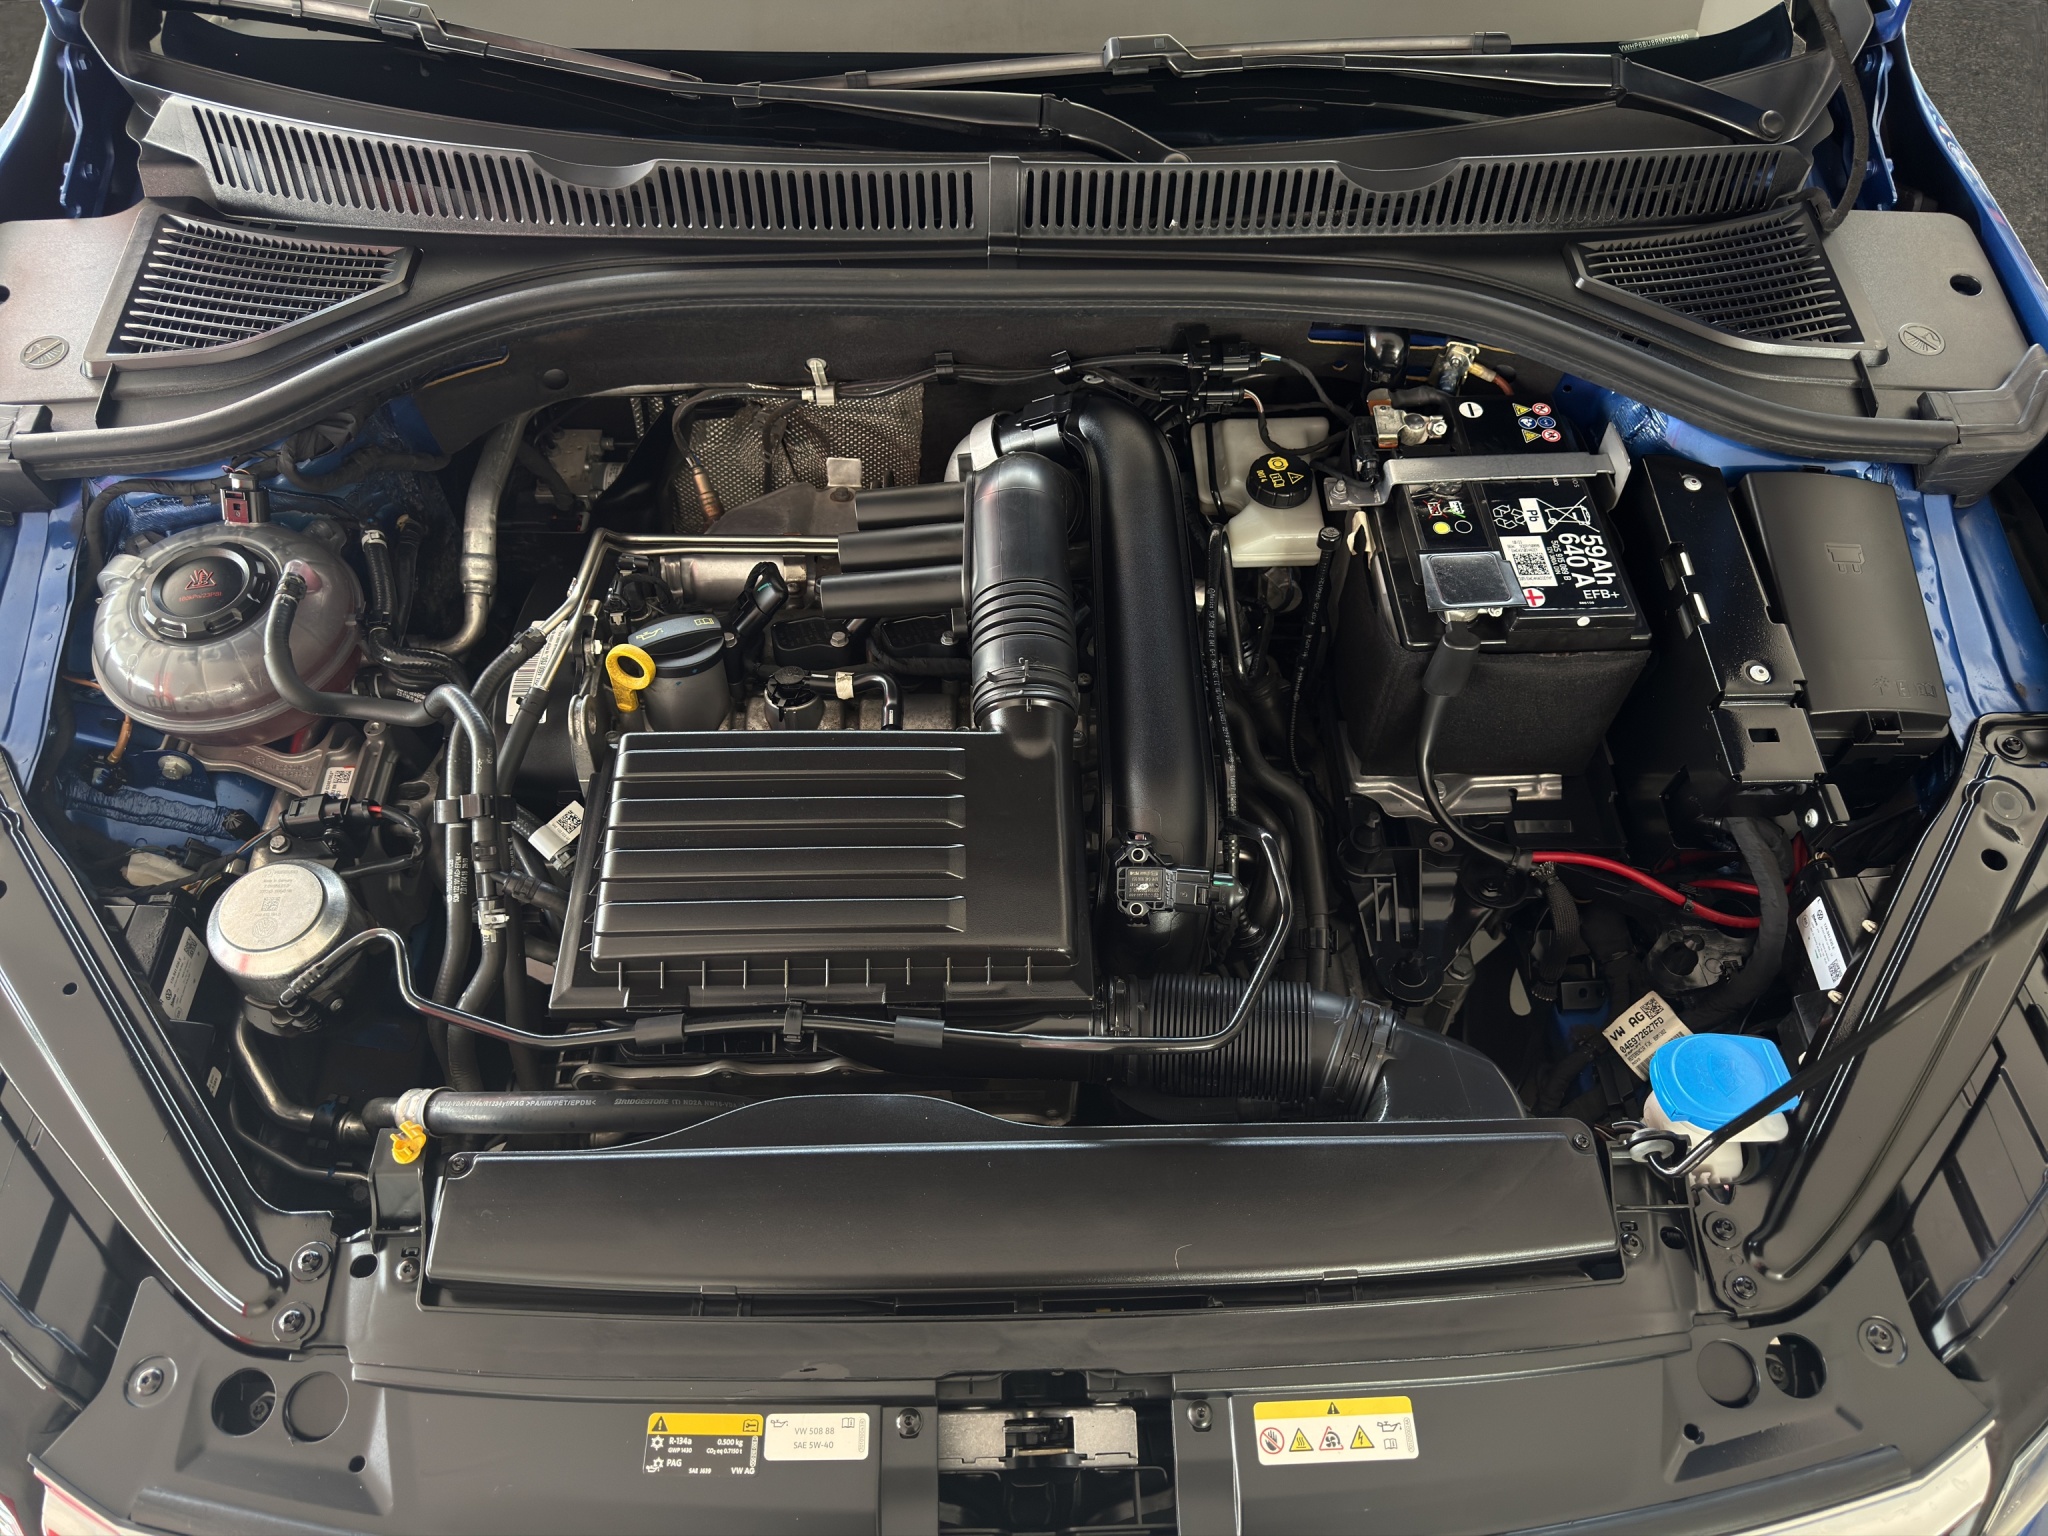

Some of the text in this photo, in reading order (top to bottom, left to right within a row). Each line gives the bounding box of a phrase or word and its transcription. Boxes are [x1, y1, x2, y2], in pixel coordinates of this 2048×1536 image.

[1257, 469, 1267, 478] DOT
[1526, 509, 1539, 522] Pb
[1558, 533, 1589, 568] 640
[1556, 553, 1565, 564] 915
[1580, 534, 1617, 585] 59Ah
[1571, 572, 1596, 588] A
[1582, 589, 1620, 600] EFB+
[1610, 1011, 1645, 1041] VW AG
[794, 1427, 835, 1435] VW 508 88
[669, 1437, 692, 1445] R-134a
[735, 1439, 744, 1448] kg
[794, 1441, 807, 1449] SAE
[666, 1459, 682, 1467] PAG
